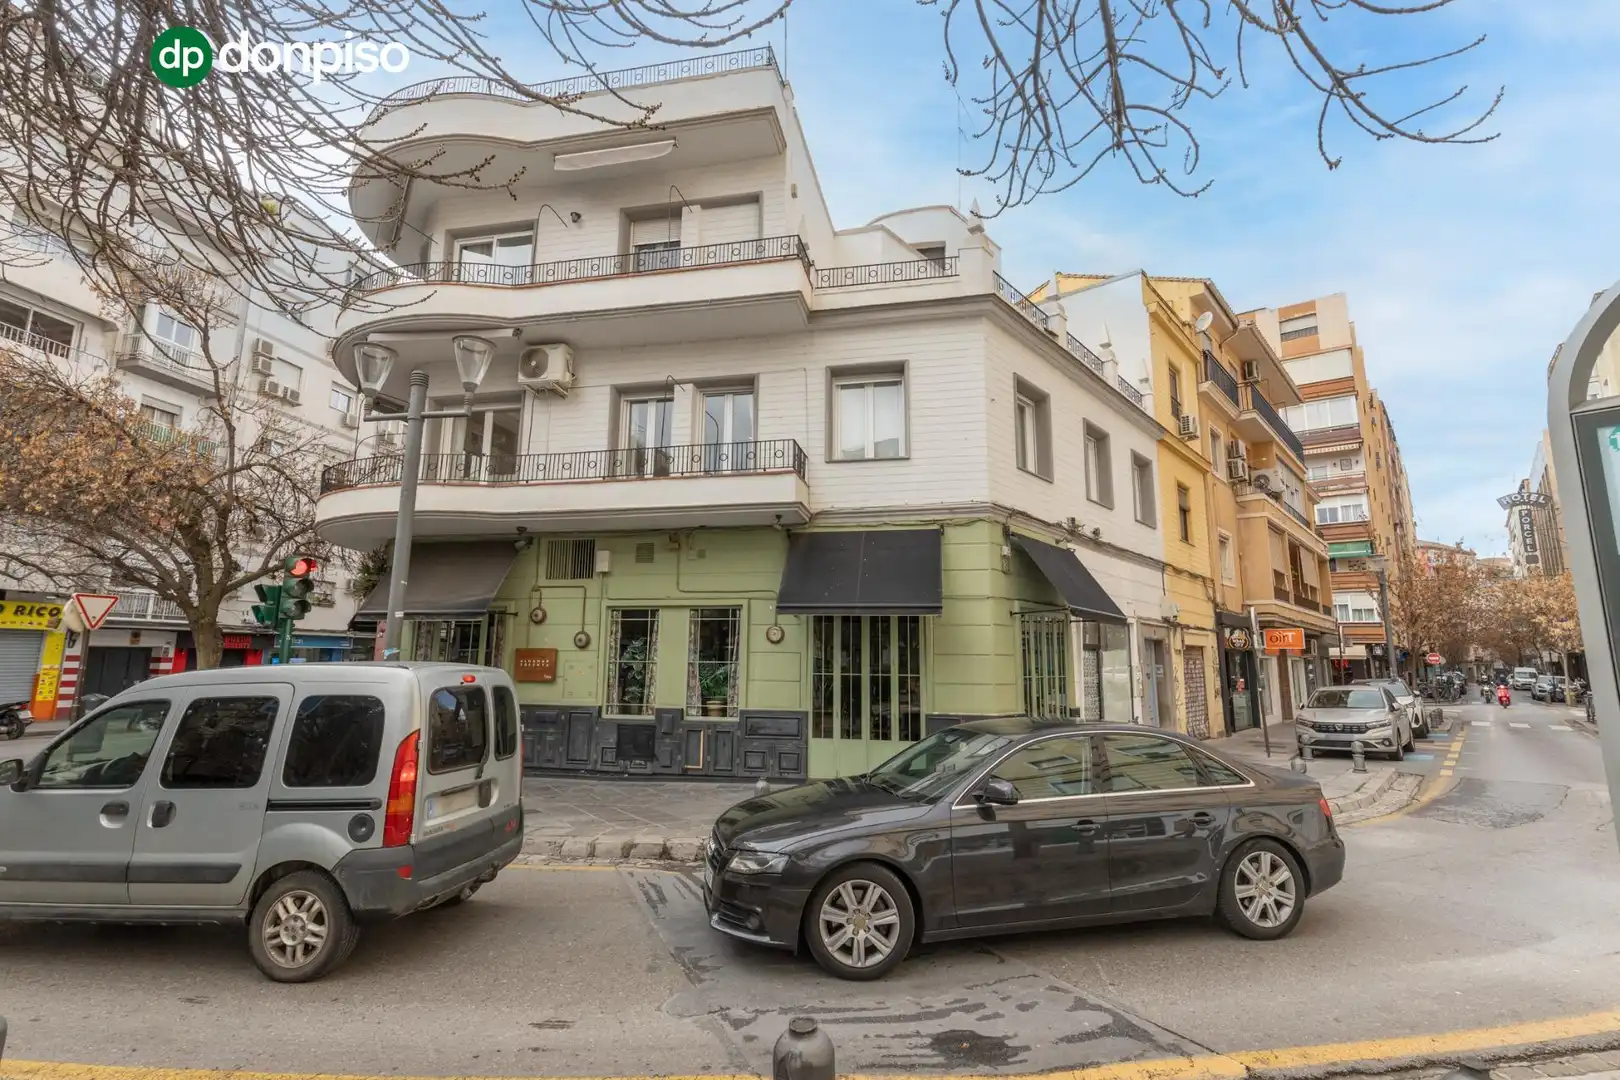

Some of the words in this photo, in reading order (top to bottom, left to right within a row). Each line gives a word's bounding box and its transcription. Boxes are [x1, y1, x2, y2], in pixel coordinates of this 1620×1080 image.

[1500, 493, 1546, 505] HOTEL
[1521, 510, 1534, 552] PORCEL
[13, 605, 61, 617] RICO
